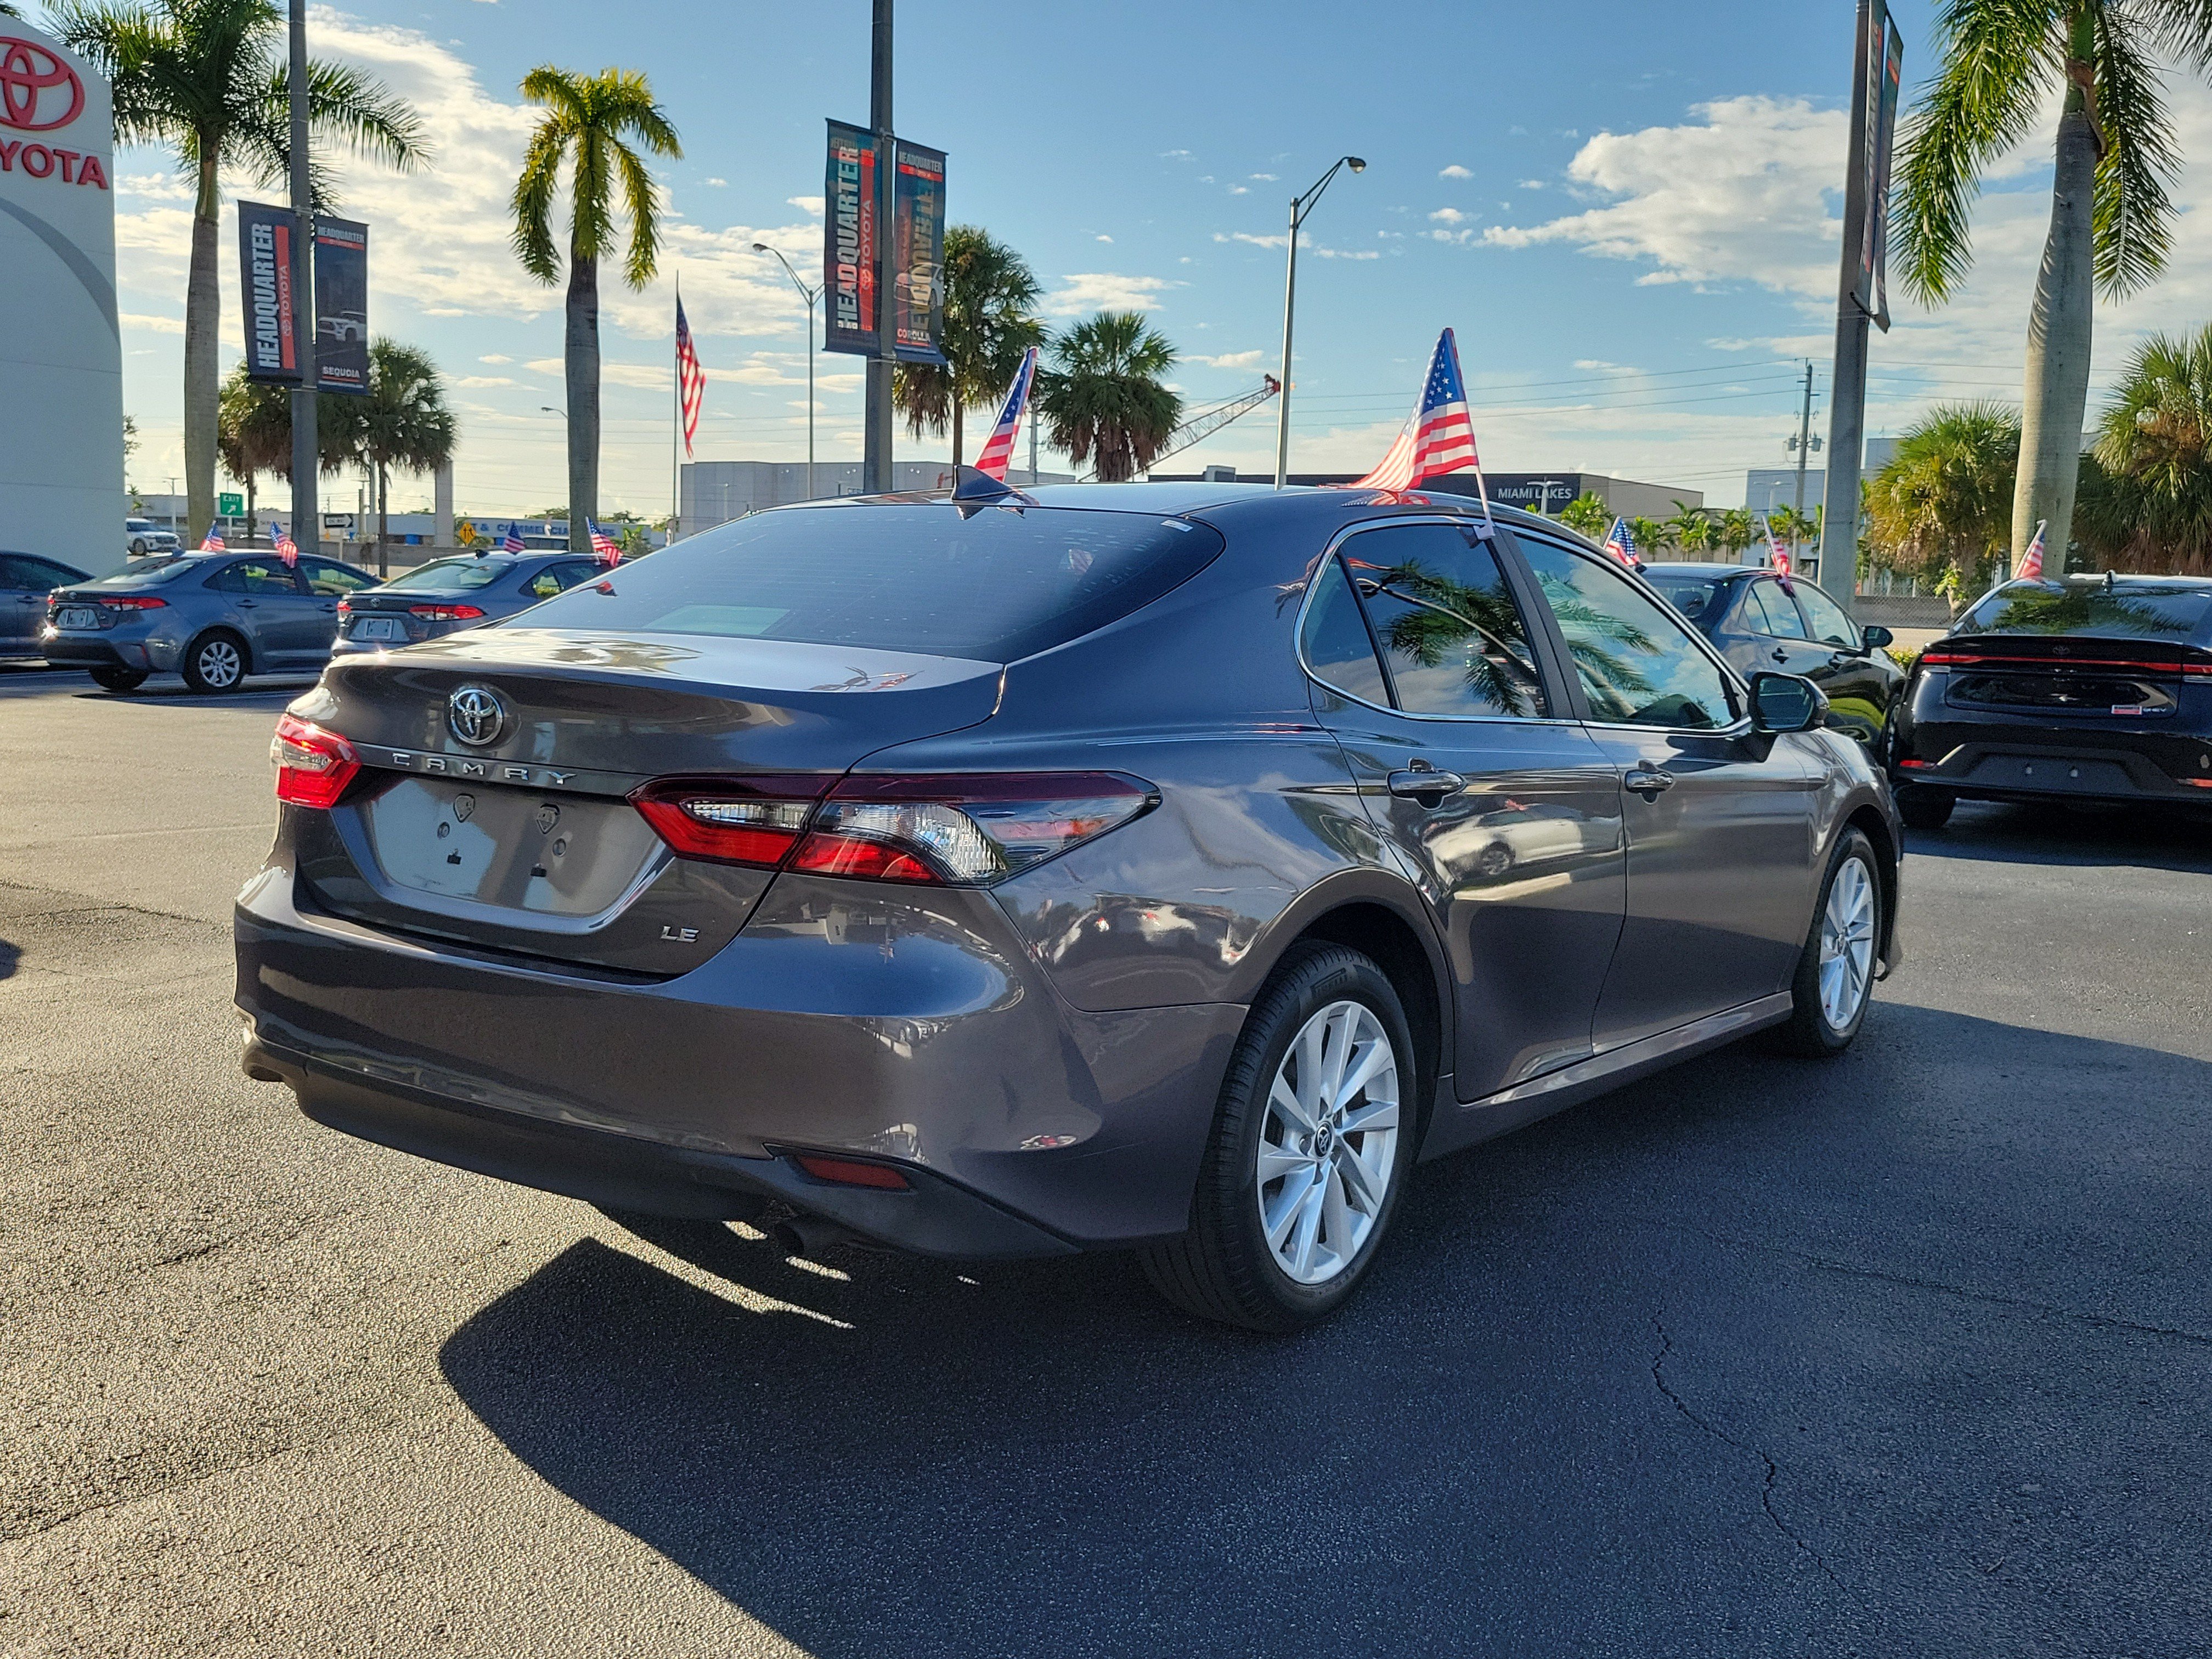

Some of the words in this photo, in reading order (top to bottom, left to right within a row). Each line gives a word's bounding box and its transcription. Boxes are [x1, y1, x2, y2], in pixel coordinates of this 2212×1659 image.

[837, 146, 860, 329] HEADQUARTER
[862, 200, 872, 267] TOYOTA
[252, 223, 280, 368] HEADQUARTER
[278, 266, 291, 318] TOYOTA
[322, 366, 360, 378] SEQUOIA
[1498, 488, 1533, 499] MIAMI
[392, 752, 577, 785] CAMRY
[661, 926, 700, 943] LE
